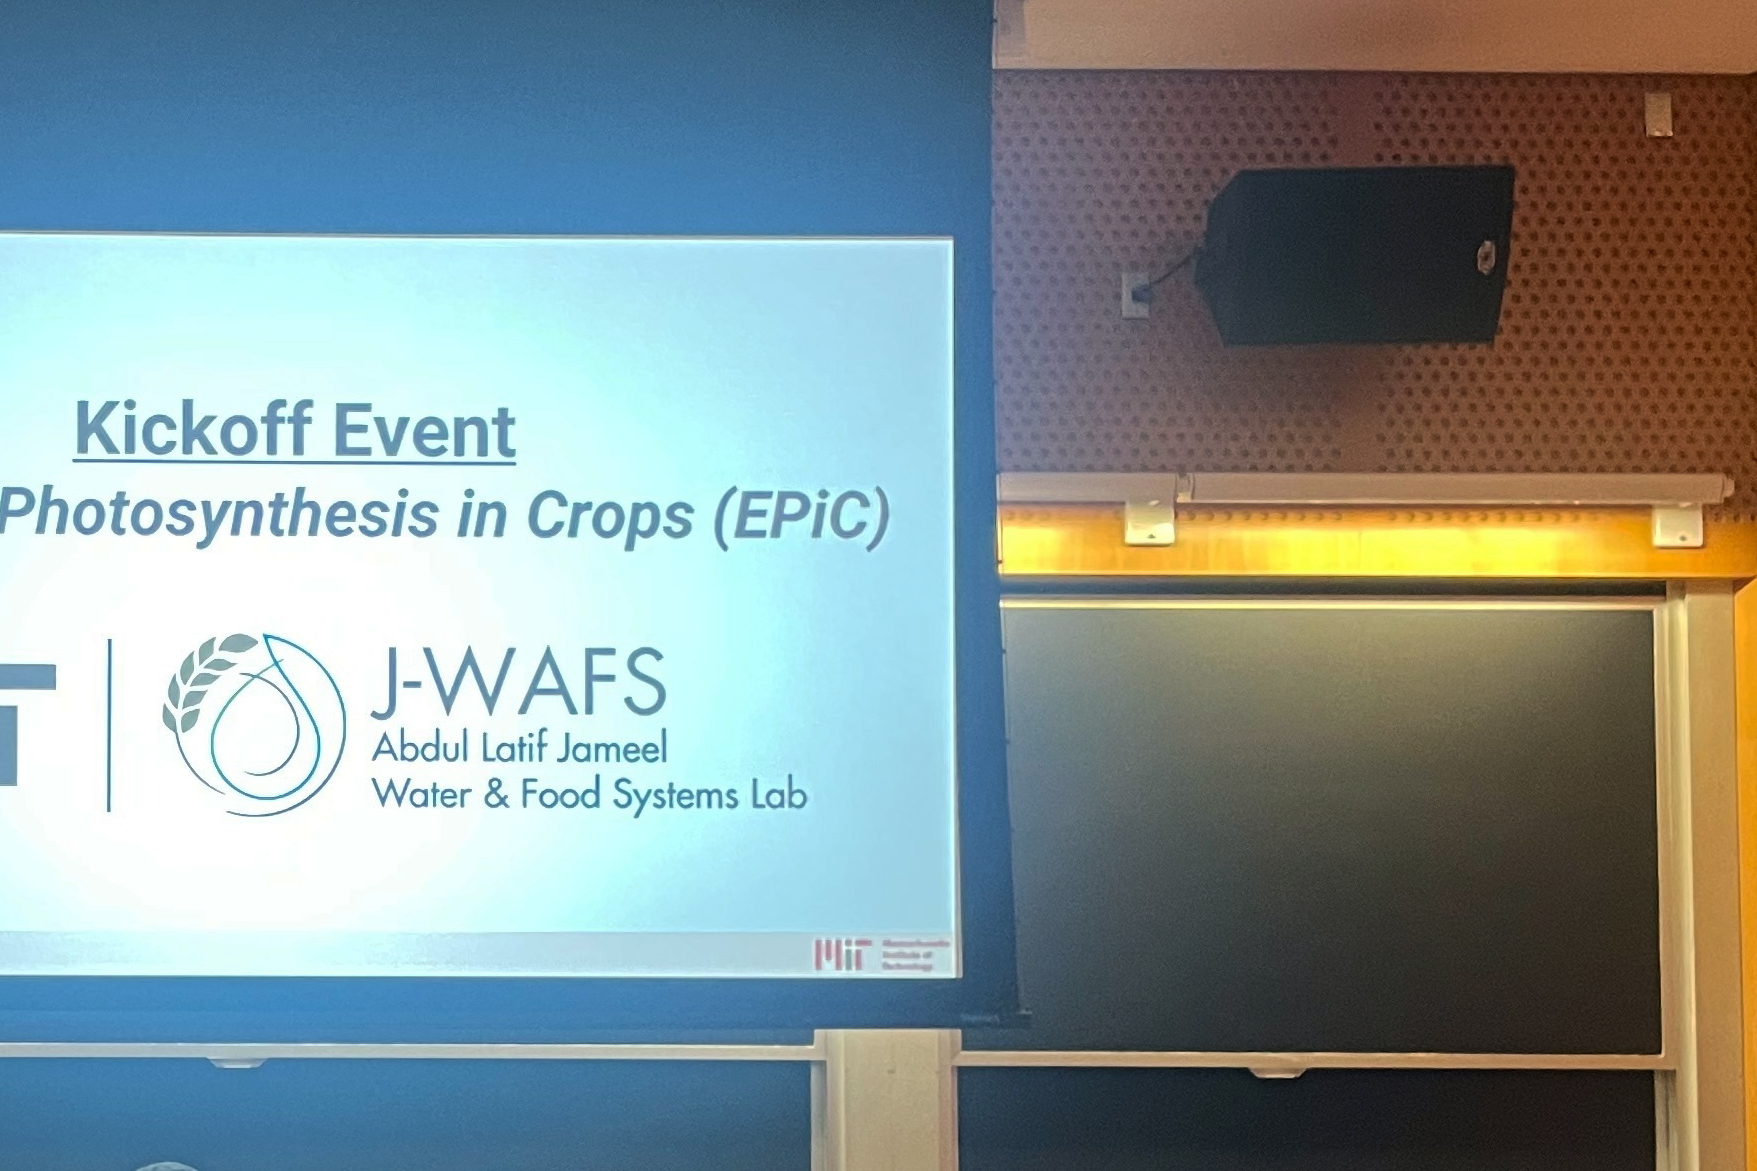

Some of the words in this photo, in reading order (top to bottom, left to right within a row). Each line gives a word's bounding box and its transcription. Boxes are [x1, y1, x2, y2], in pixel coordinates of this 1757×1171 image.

[76, 398, 315, 458] Kickoff
[335, 402, 517, 459] Event
[456, 487, 507, 538] in
[527, 490, 696, 553] Crops
[713, 485, 890, 553] (EPiC)
[369, 644, 667, 721] J-WAFS
[371, 726, 469, 763] Abdul
[482, 726, 549, 763] Latif
[556, 726, 667, 764] Jameel
[370, 777, 473, 809] Water
[483, 777, 511, 809] &
[521, 773, 601, 810] Food
[612, 776, 740, 820] Systems
[751, 772, 809, 811] Lab
